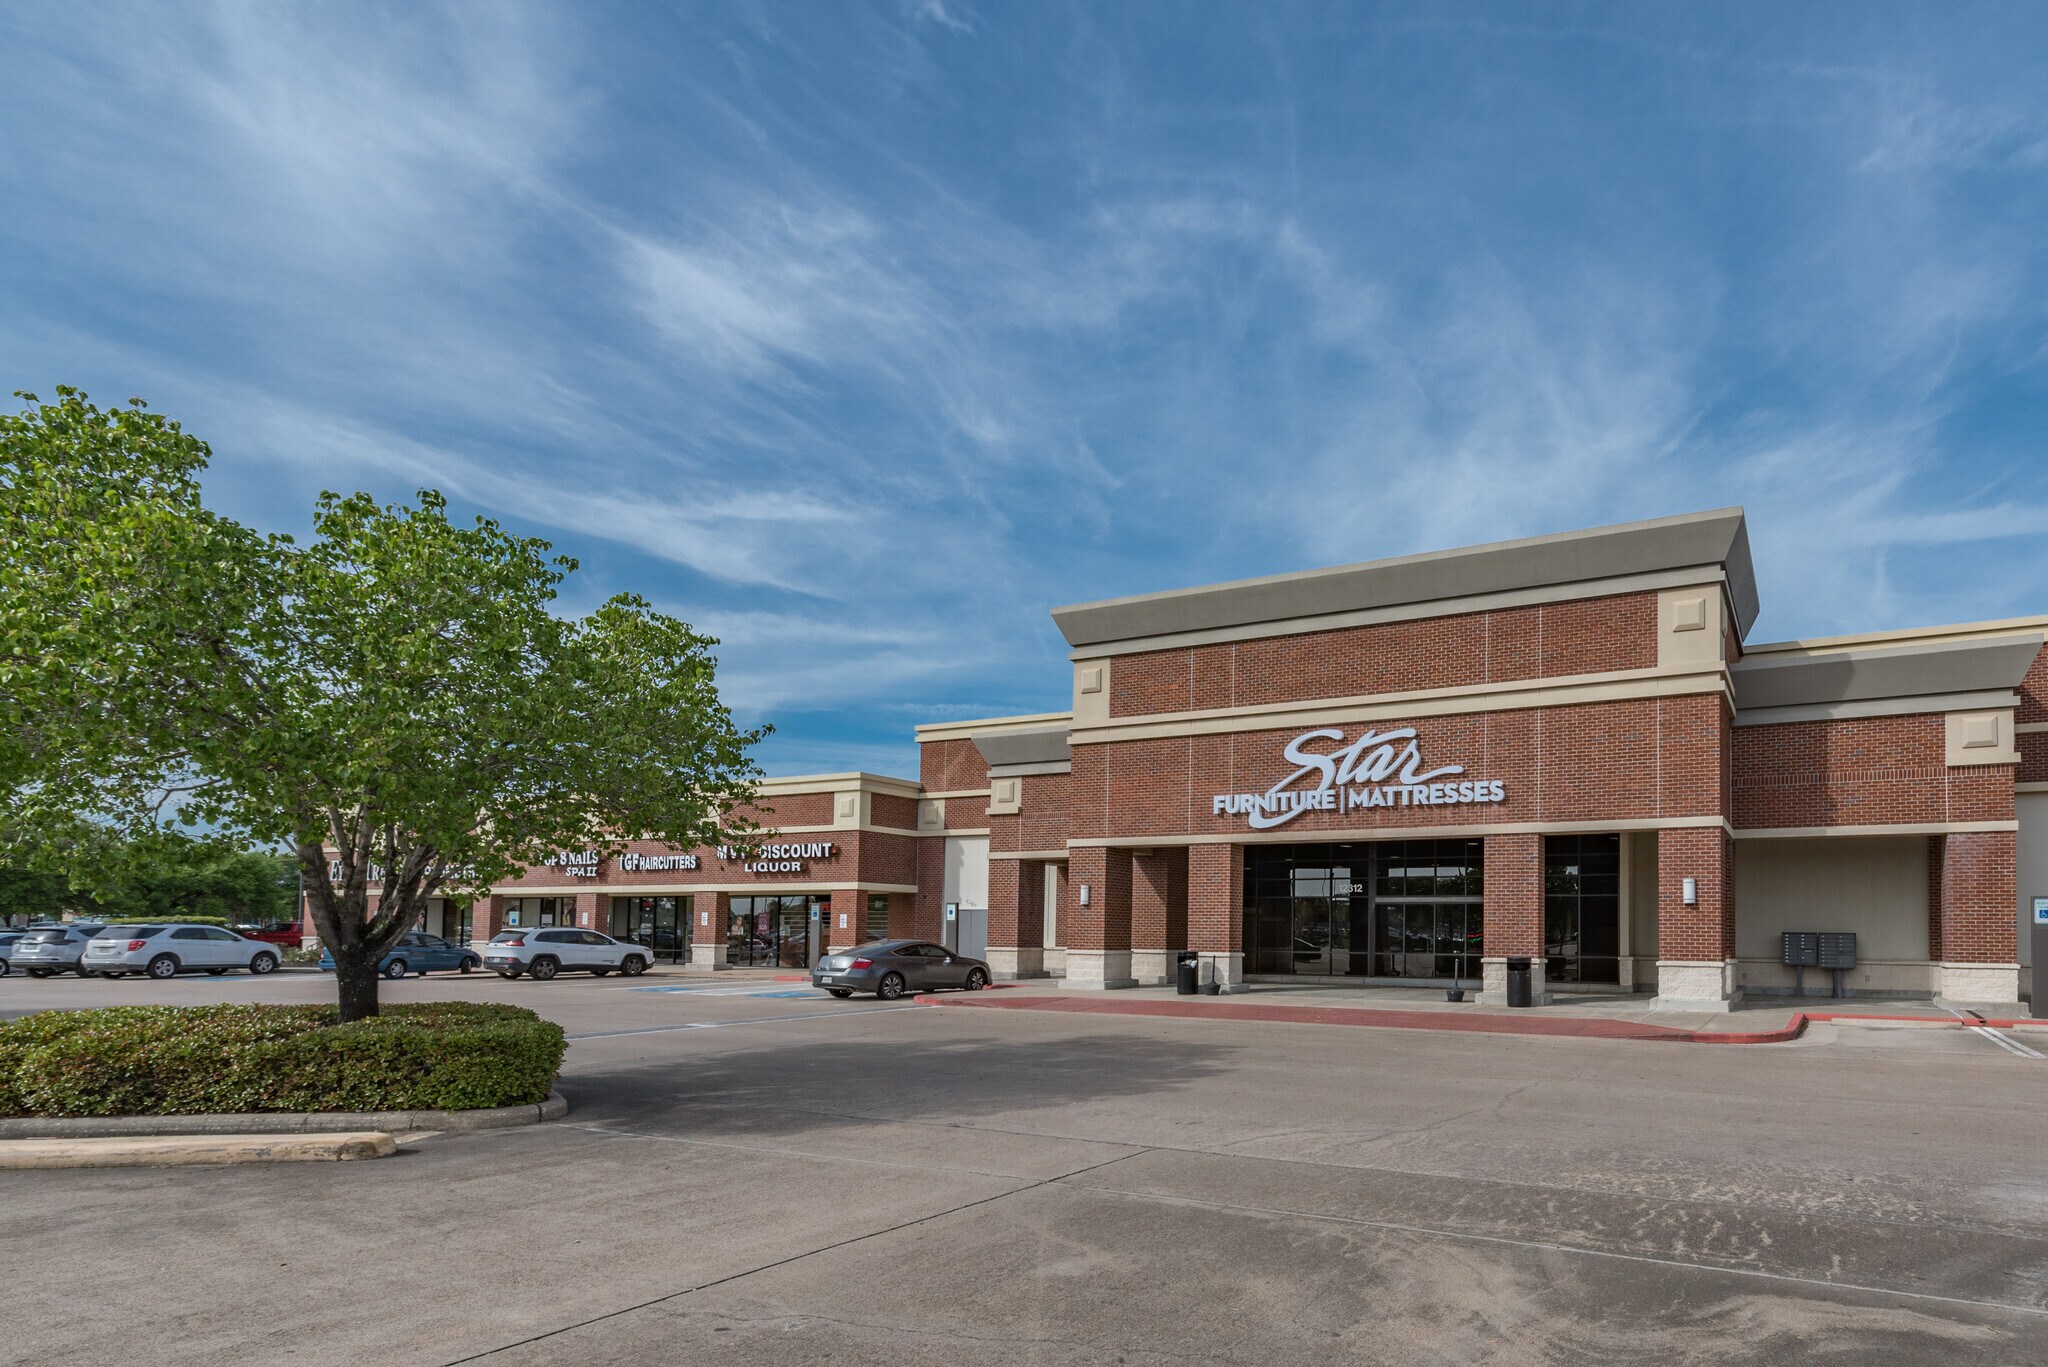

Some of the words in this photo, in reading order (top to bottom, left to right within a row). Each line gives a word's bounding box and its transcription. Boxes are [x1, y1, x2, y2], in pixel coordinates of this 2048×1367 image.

[1248, 727, 1464, 829] Star
[1212, 788, 1337, 815] FURNITURE
[1348, 779, 1506, 808] MATTRESSES
[560, 851, 567, 866] 8
[569, 850, 599, 865] NAILS
[759, 843, 832, 859] DISCOUNT
[640, 855, 696, 871] HAIRCUTTERS
[744, 861, 801, 872] LIQUOR
[565, 866, 586, 877] SPA
